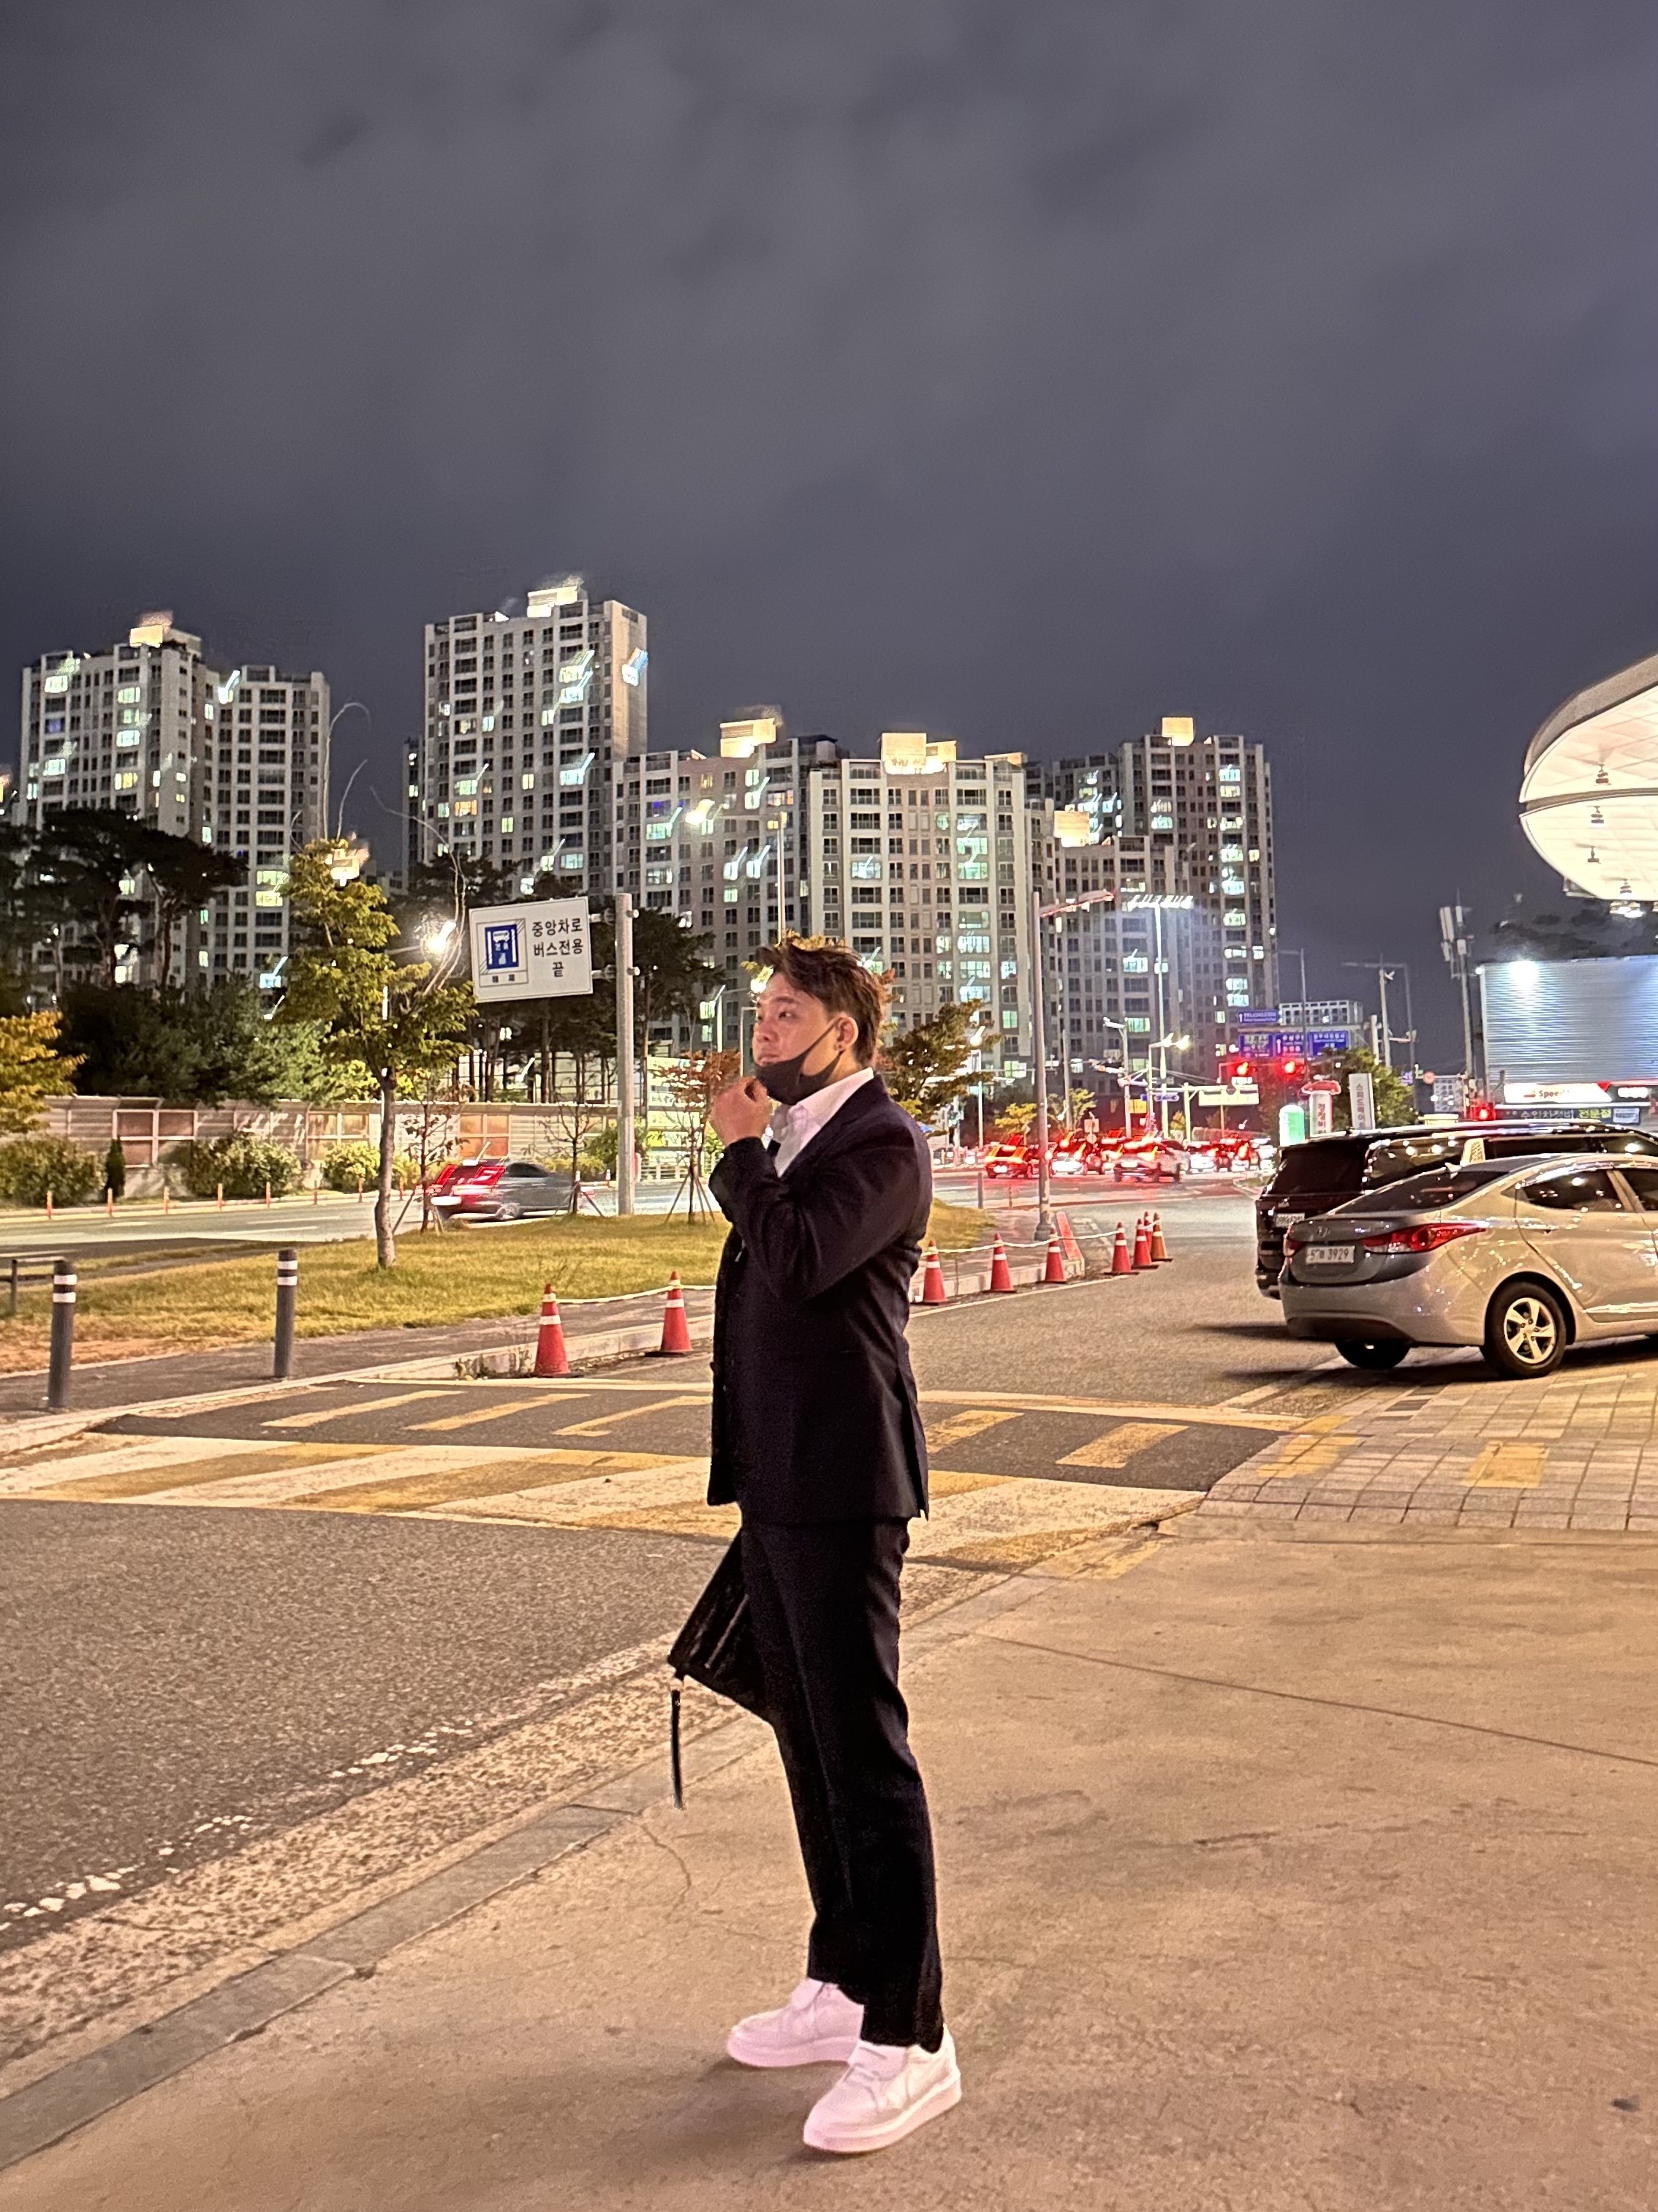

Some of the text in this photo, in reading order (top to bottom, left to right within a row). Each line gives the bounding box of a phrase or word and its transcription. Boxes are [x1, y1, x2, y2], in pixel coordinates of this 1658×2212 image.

[532, 918, 583, 937] 중앙차로
[534, 938, 583, 957] 버스전용
[552, 961, 564, 977] 끝
[1328, 1247, 1349, 1261] 3929
